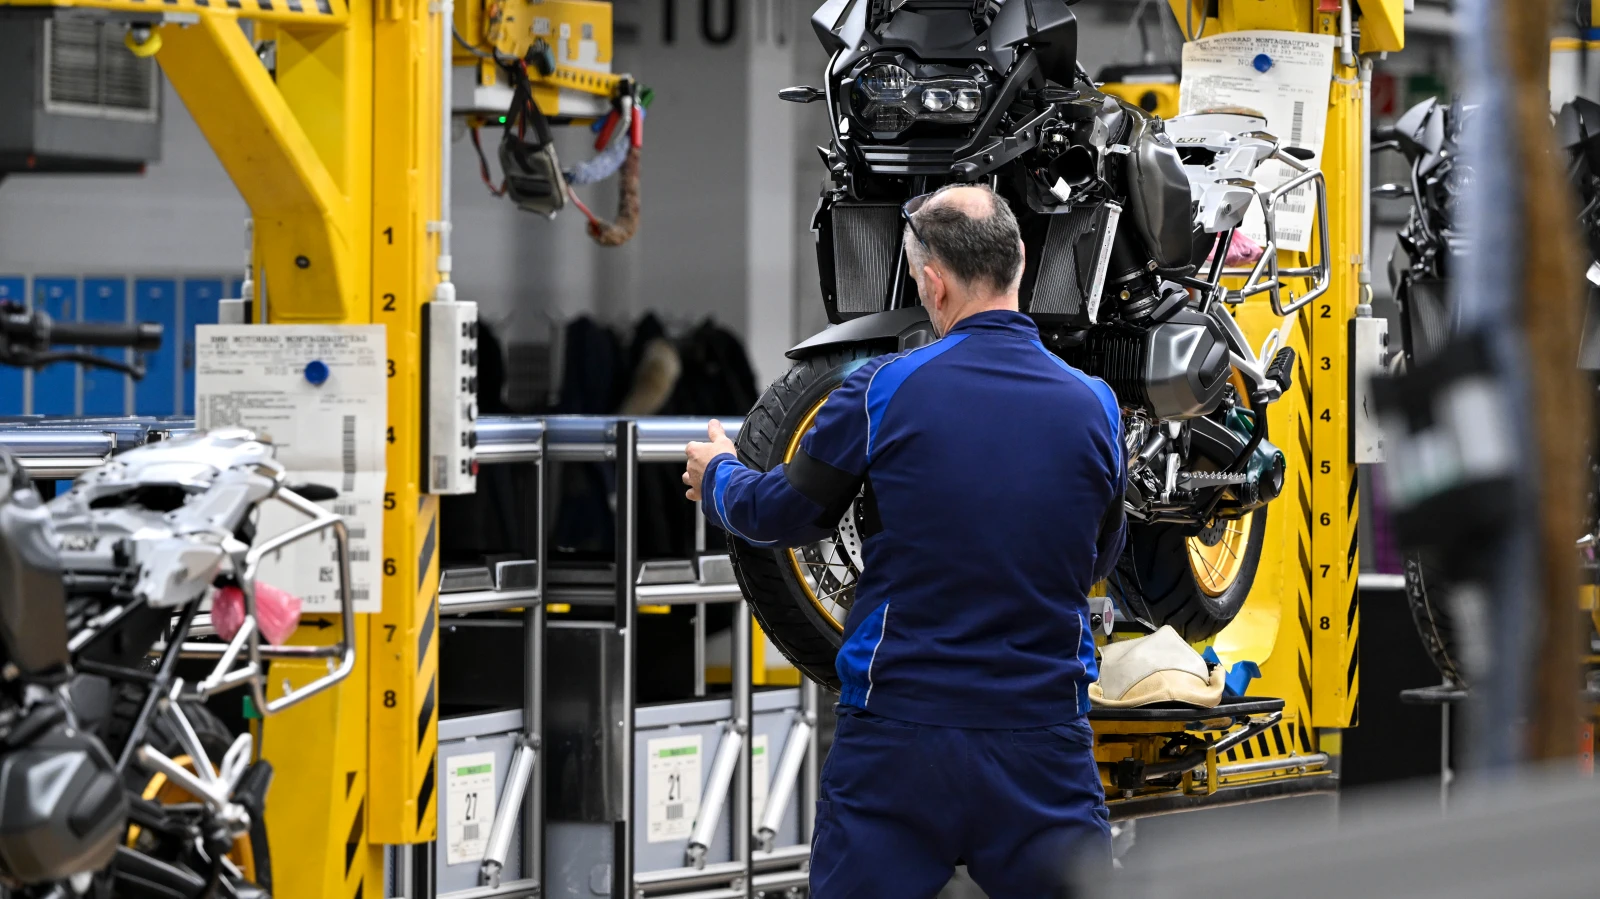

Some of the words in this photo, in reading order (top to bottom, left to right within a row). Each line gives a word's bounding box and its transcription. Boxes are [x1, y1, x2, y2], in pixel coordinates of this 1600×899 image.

[382, 226, 393, 245] 1
[382, 293, 396, 312] 2
[1320, 304, 1331, 318] 2
[386, 359, 396, 378] 3
[1320, 357, 1331, 371] 3
[1319, 409, 1331, 422] 4
[386, 426, 396, 444] 4
[1320, 460, 1331, 474] 5
[383, 492, 396, 510] 5
[1319, 512, 1331, 526] 6
[383, 558, 397, 576] 6
[1319, 564, 1331, 578] 7
[1319, 616, 1331, 630] 8
[383, 624, 397, 643] 7
[383, 690, 397, 708] 8
[668, 774, 681, 801] 21
[465, 793, 478, 821] 27
